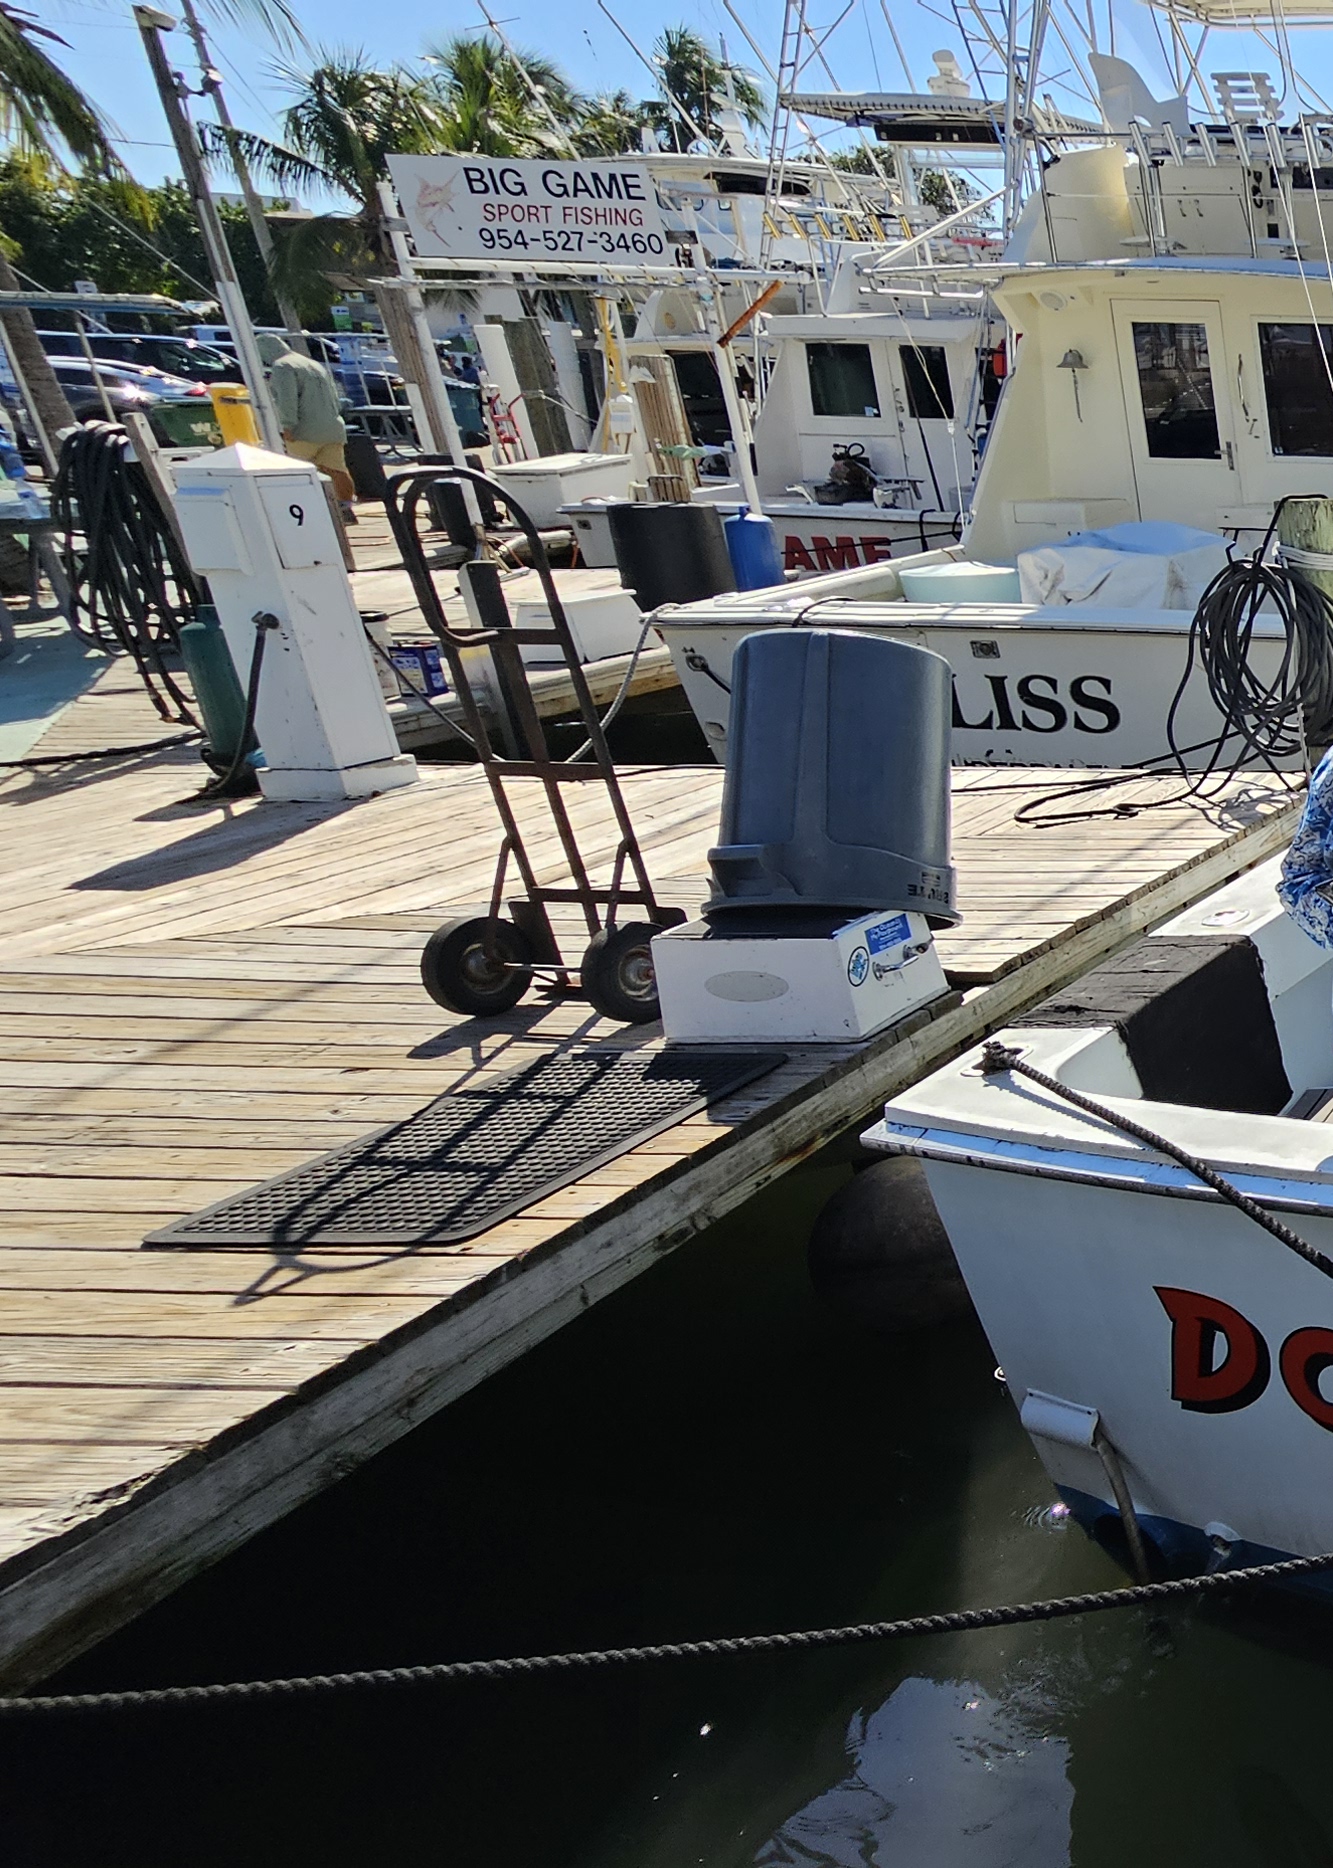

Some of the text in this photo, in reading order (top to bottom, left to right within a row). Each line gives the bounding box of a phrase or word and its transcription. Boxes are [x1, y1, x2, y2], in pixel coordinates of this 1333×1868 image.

[463, 166, 647, 202] BIG GAME
[483, 203, 644, 227] SPORT FISHING
[478, 227, 664, 255] 954-527-3460
[288, 504, 304, 527] 9
